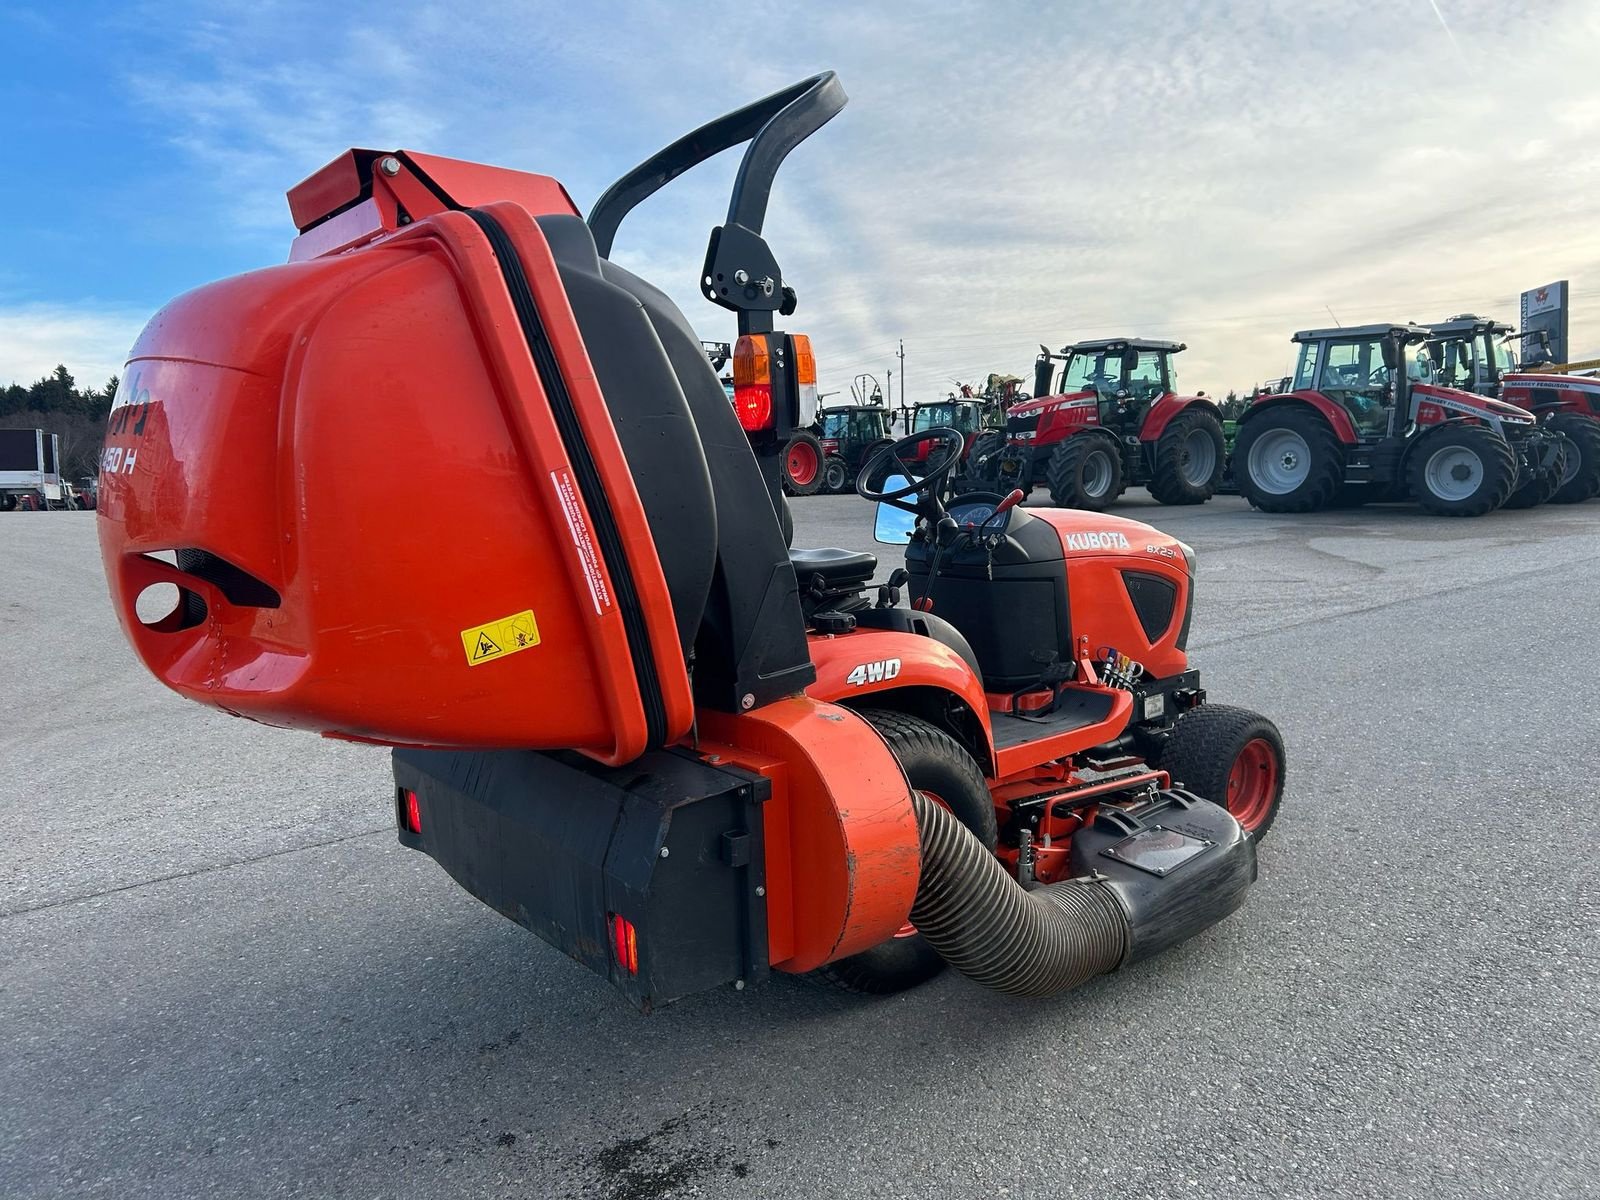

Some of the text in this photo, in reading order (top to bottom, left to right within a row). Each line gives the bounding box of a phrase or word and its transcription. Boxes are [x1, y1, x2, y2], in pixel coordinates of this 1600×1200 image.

[1425, 396, 1447, 405] MASSEY
[1447, 402, 1476, 414] FERGUSON
[562, 473, 575, 500] SYSTEM
[561, 483, 577, 522] PUISSANTE
[573, 501, 587, 532] LOCKING
[584, 533, 598, 568] POWERFUL
[1065, 532, 1131, 551] KUBOTA
[587, 563, 603, 600] ATTENTION
[598, 580, 611, 606] BEWARE
[846, 658, 902, 687] 4WD
